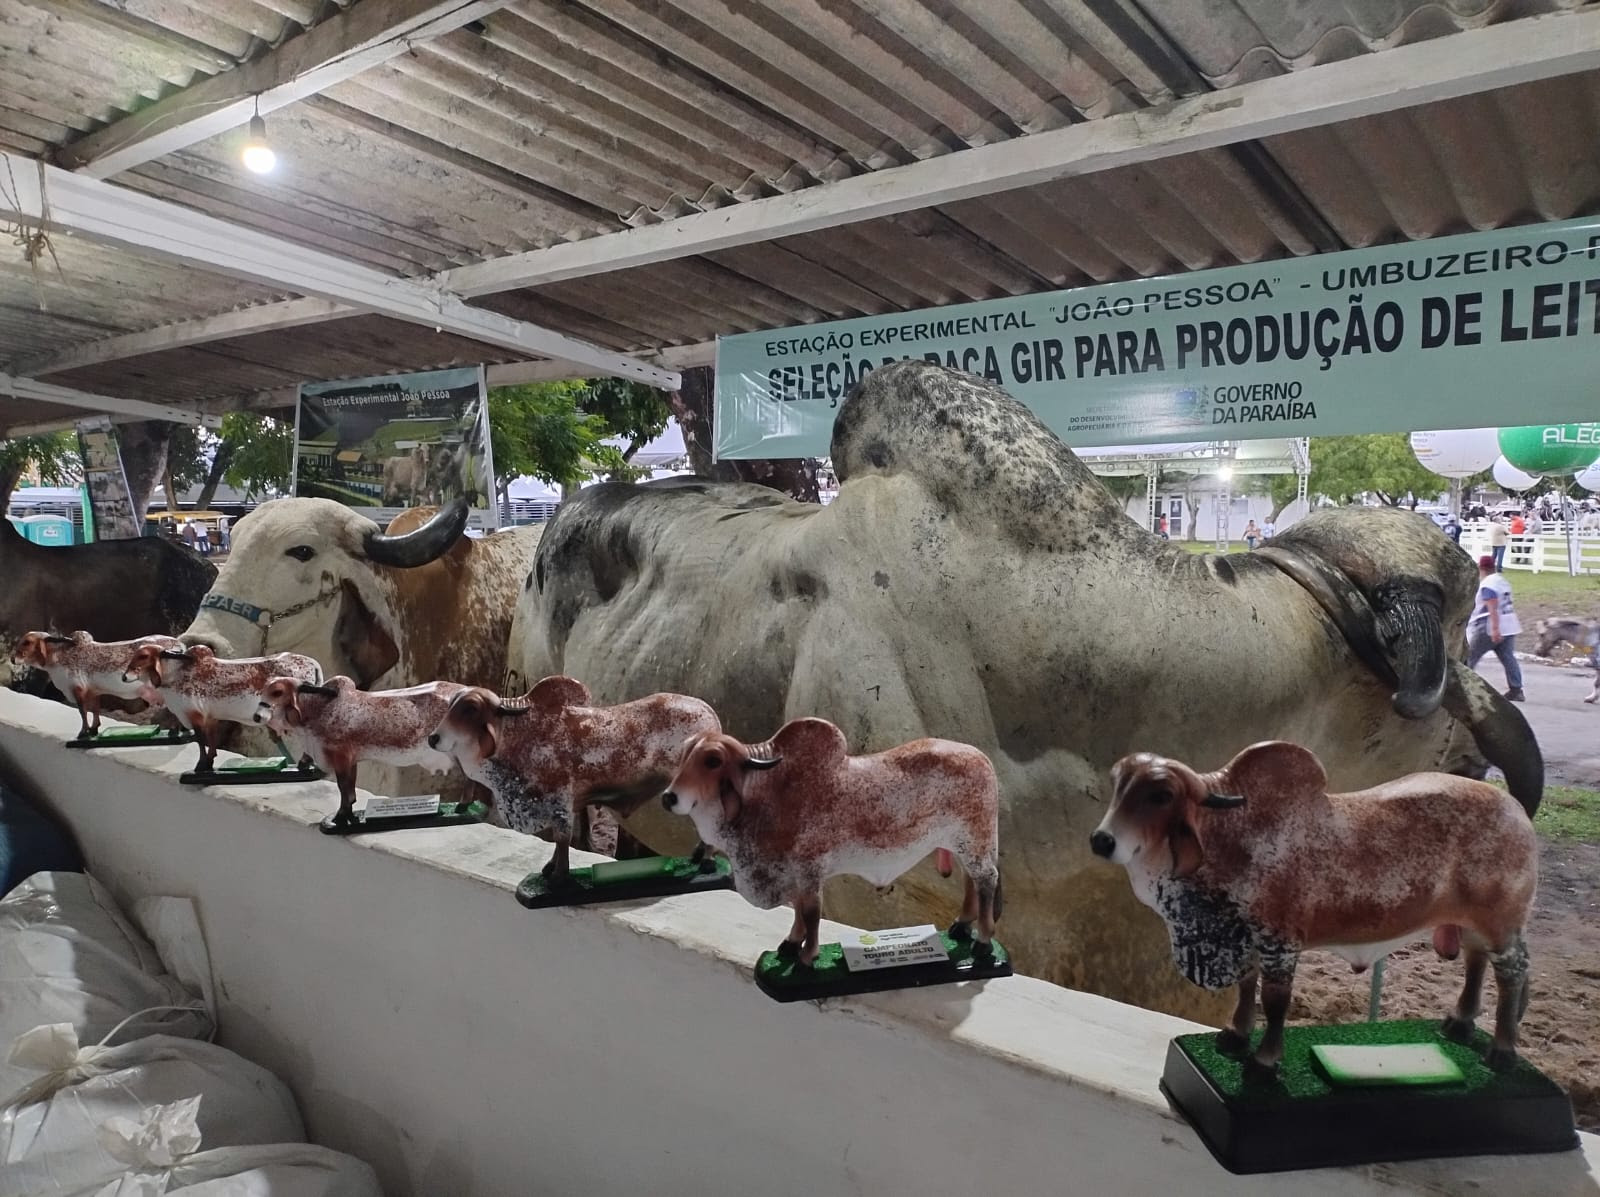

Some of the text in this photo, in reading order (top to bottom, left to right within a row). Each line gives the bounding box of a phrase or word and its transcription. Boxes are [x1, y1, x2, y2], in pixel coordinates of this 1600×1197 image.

[765, 332, 853, 356] ESTAÇÃO
[860, 310, 1036, 346] EXPERIMENTAL
[1011, 338, 1066, 384] GIR
[1074, 327, 1166, 378] PARA
[1176, 293, 1404, 371] PRODUÇÃO
[1421, 292, 1482, 349] DE
[322, 397, 349, 409] Estação
[350, 391, 400, 406] Experimental
[421, 389, 451, 400] Pessoa
[1213, 381, 1303, 404] GOVERNO
[1212, 400, 1318, 425] DA PARAÍBA
[862, 951, 896, 960] TOURO
[897, 946, 935, 956] ADULTO
[863, 941, 928, 953] CAMPEONATO
